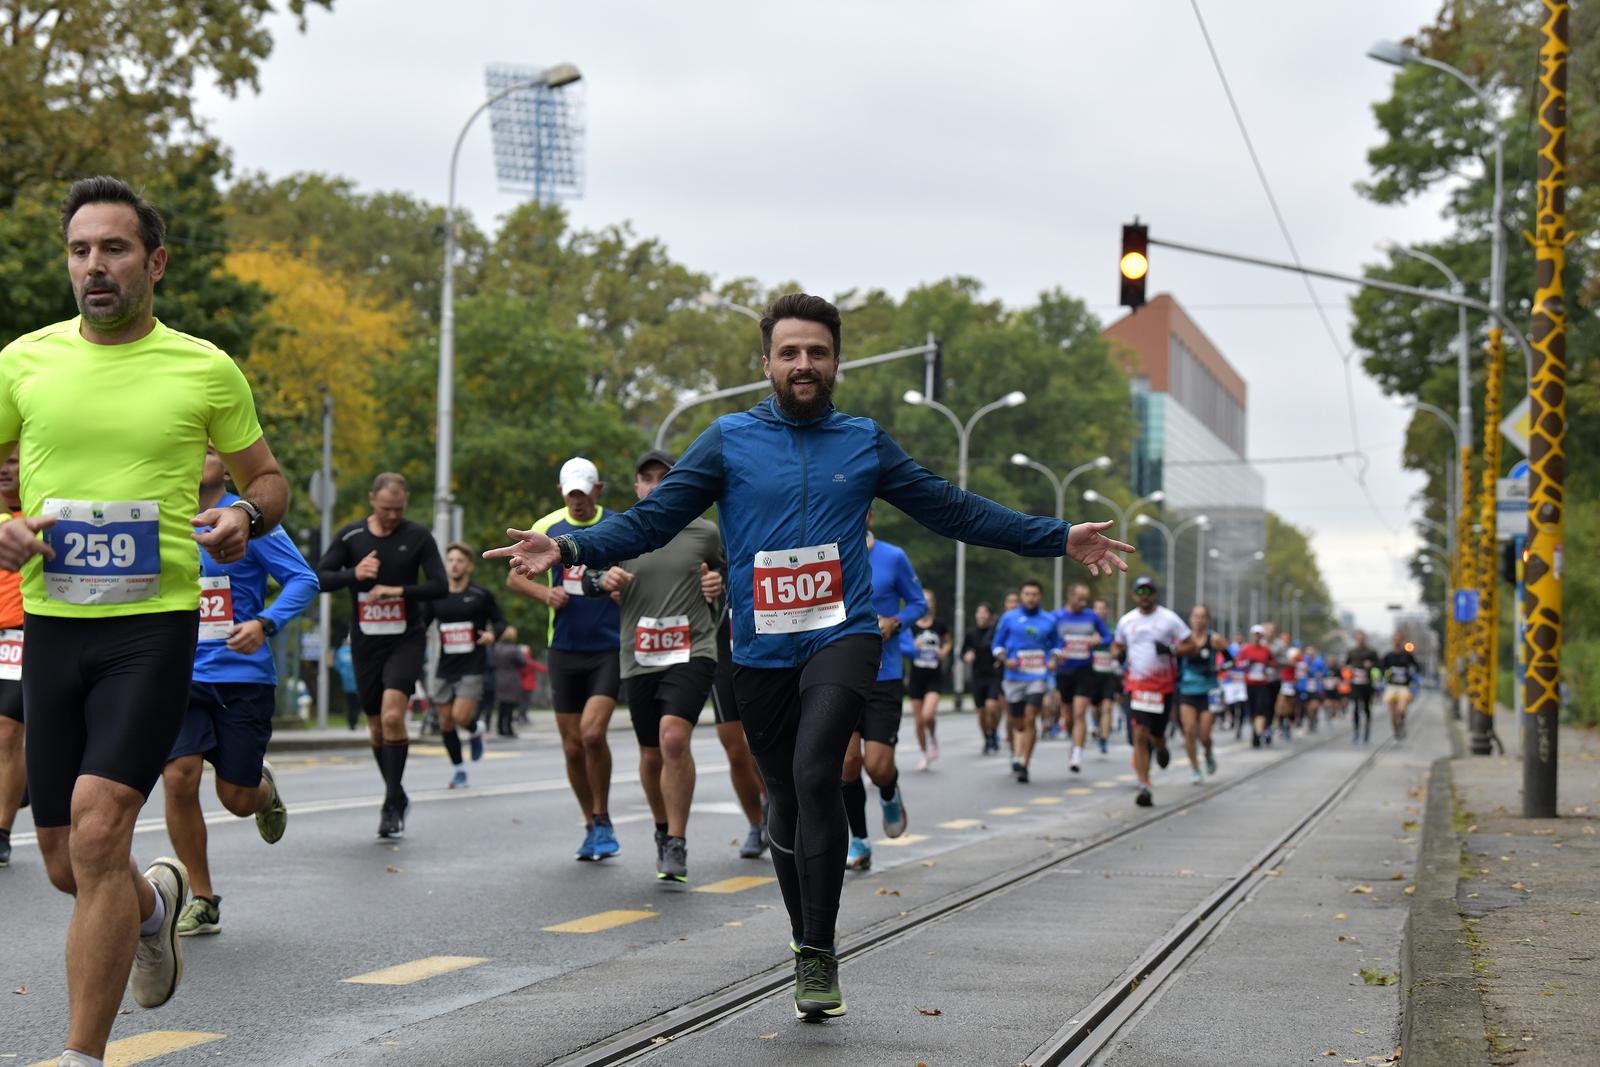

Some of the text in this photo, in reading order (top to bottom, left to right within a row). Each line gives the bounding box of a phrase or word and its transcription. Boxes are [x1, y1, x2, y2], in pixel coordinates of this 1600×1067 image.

[64, 532, 136, 568] 259
[761, 571, 833, 604] 1502
[363, 604, 401, 620] 2044
[640, 631, 685, 650] 2162
